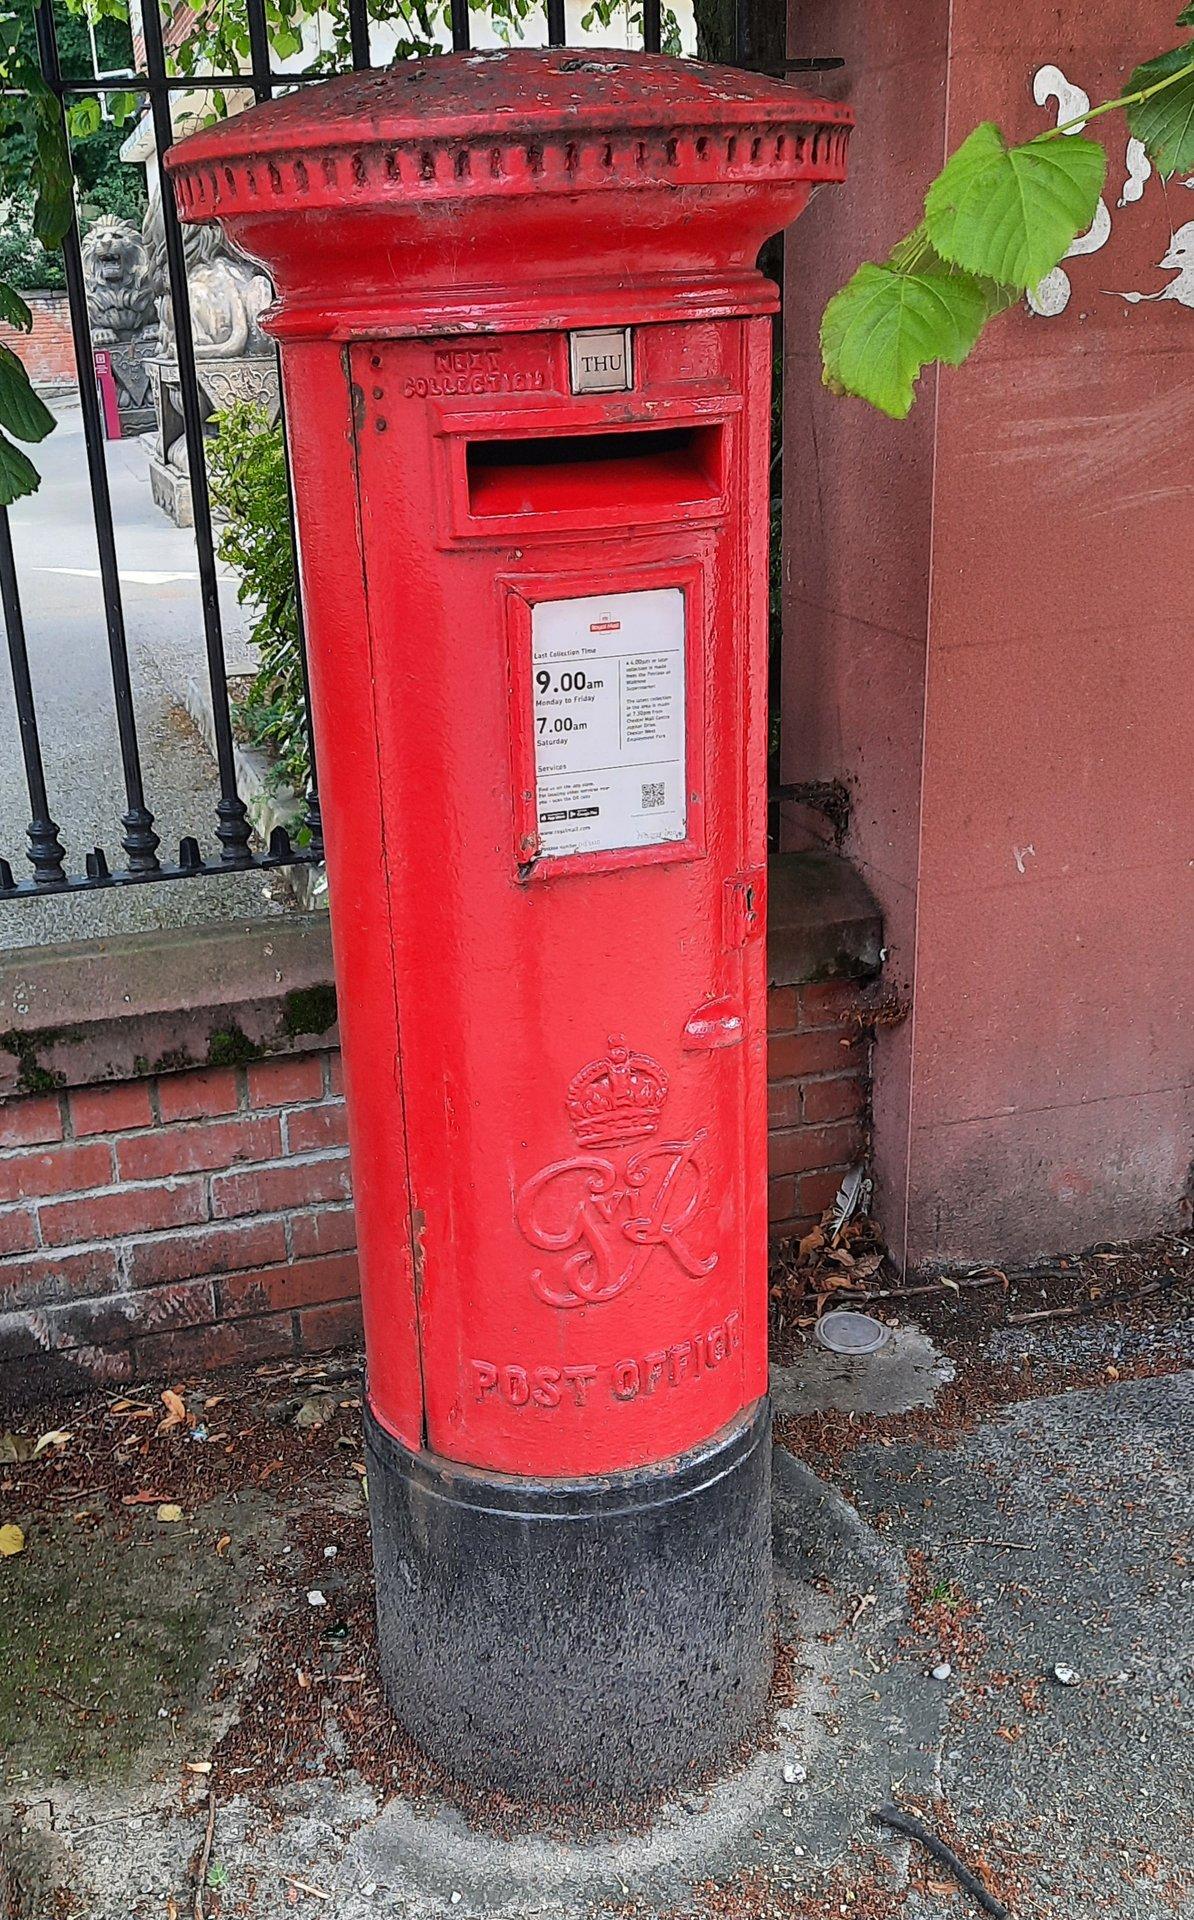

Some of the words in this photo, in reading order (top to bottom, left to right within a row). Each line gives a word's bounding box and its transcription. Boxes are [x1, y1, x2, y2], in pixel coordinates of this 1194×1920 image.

[581, 354, 622, 373] THU
[403, 370, 545, 398] COLLECTION
[549, 648, 580, 658] Collection
[535, 670, 604, 694] 9.00am
[536, 698, 562, 707] Monday
[573, 695, 596, 703] Friday
[536, 717, 588, 734] 7.00am
[536, 738, 569, 747] Saturday
[537, 764, 567, 773] Services
[472, 1358, 600, 1408] POST
